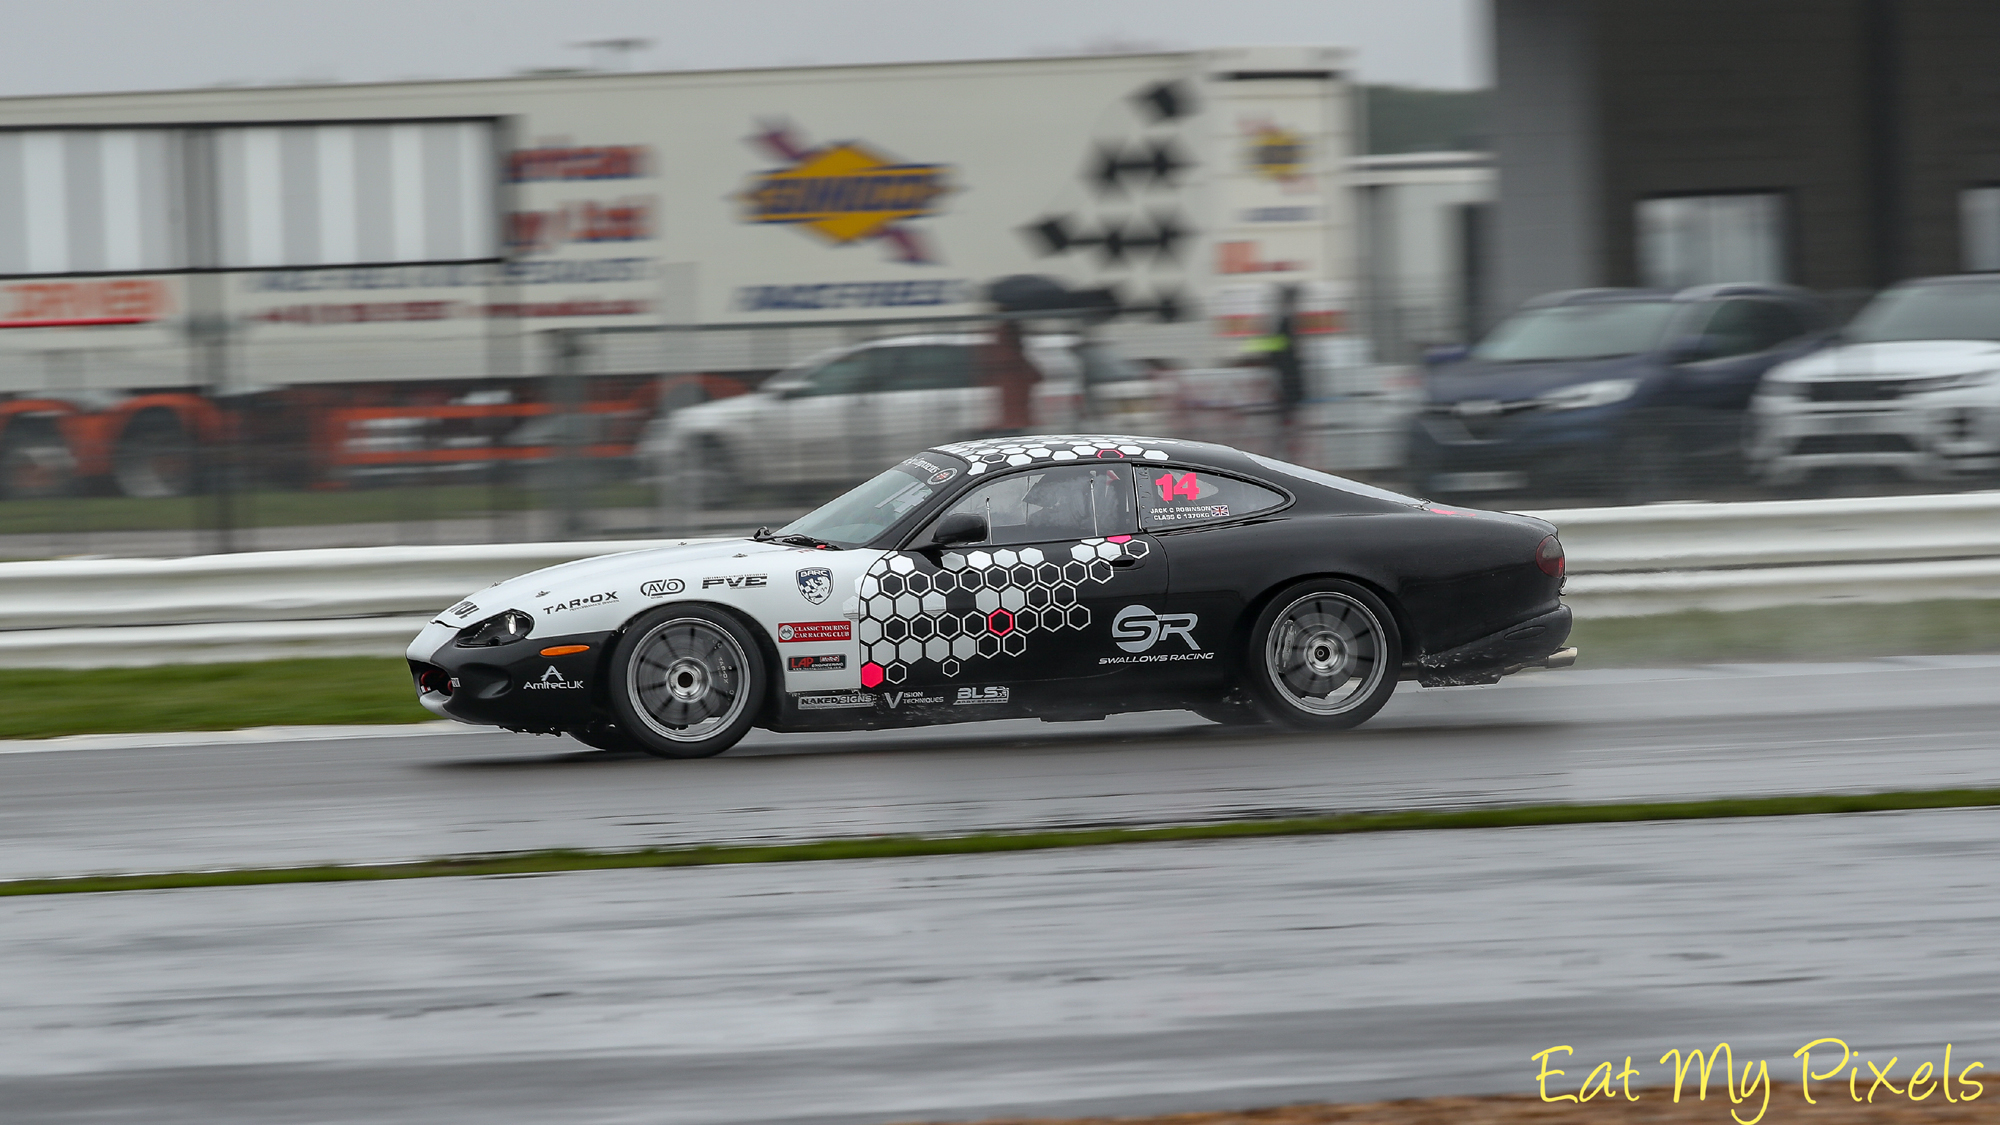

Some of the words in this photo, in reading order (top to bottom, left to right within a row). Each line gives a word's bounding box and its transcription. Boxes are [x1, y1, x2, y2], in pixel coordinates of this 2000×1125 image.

[1155, 472, 1200, 501] 14
[1175, 505, 1211, 513] ROBINSON
[647, 580, 679, 597] AVO
[701, 575, 768, 590] PVE
[791, 657, 814, 668] LAP
[1098, 654, 1168, 665] SWALLOWS
[1169, 652, 1215, 661] RACING
